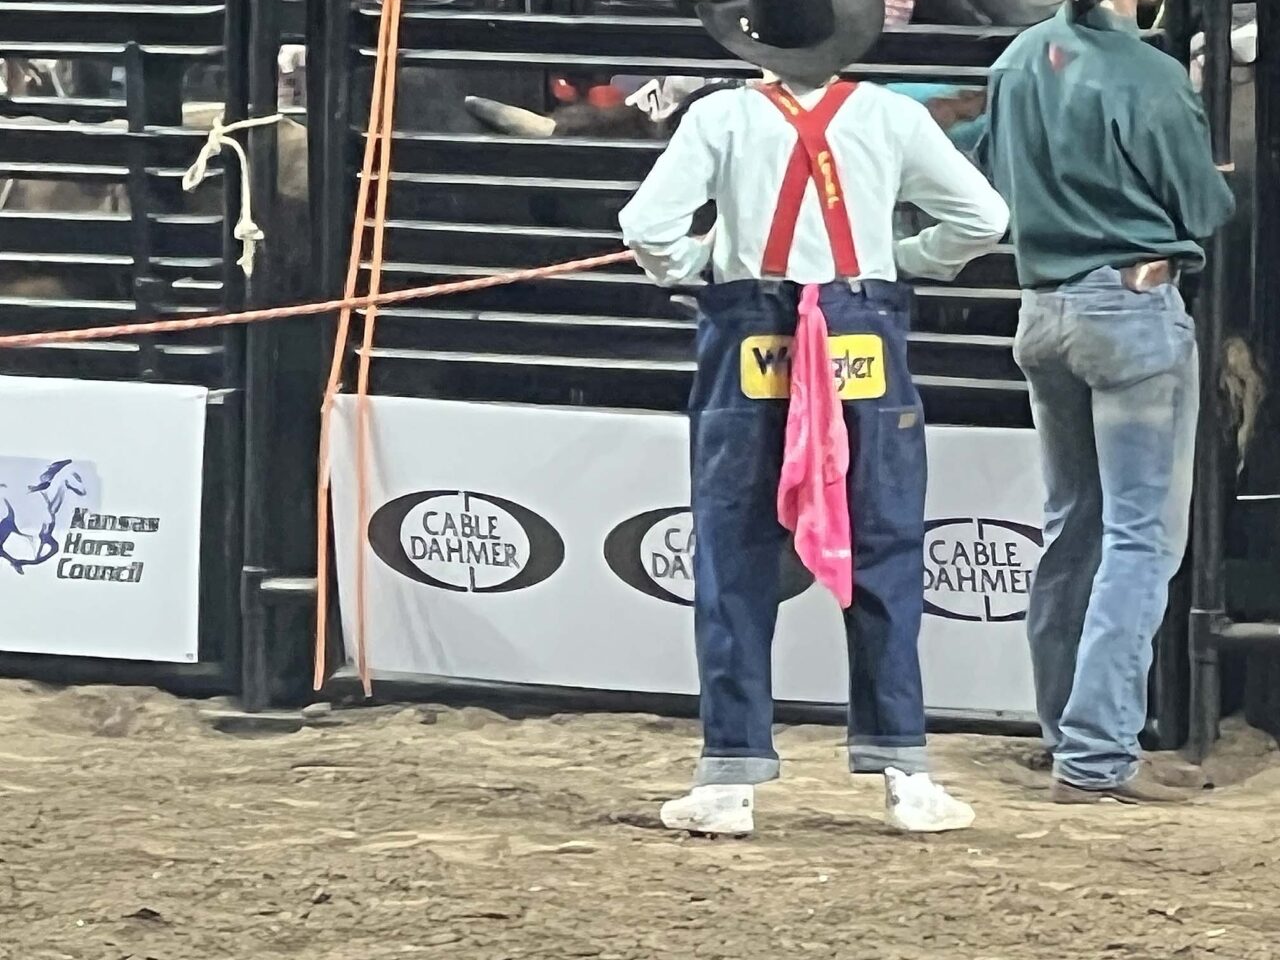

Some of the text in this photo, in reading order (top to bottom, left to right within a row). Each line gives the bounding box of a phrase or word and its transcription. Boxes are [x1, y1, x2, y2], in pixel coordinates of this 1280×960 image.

[752, 346, 874, 392] Wgler
[70, 507, 160, 532] Kansas
[422, 511, 501, 540] CABLE
[63, 533, 135, 557] Horse
[410, 536, 520, 569] DAHMER
[929, 540, 1022, 567] CABLE
[56, 558, 144, 583] Council
